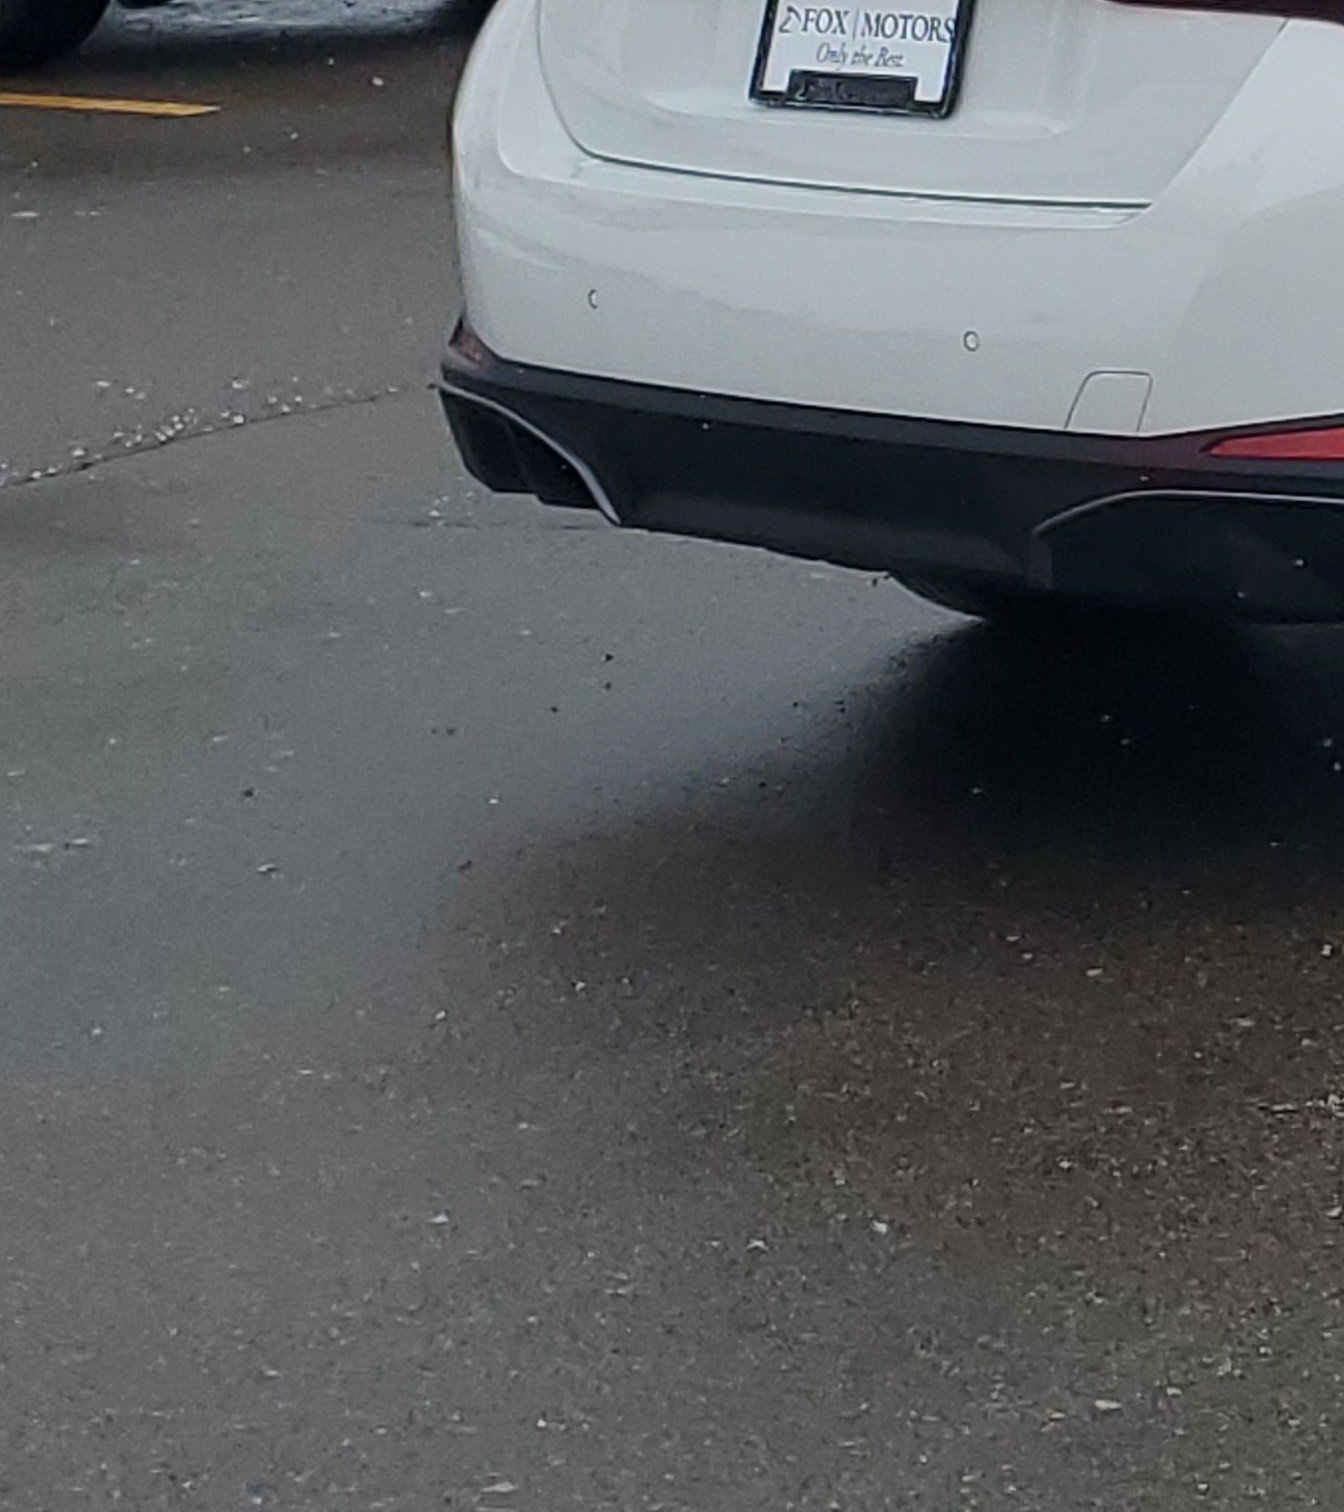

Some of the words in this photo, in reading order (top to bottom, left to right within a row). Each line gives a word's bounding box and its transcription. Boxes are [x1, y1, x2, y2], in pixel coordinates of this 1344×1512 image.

[801, 8, 849, 35] FOX
[862, 12, 955, 43] MOTORS
[816, 40, 847, 71] Only
[850, 45, 874, 67] the
